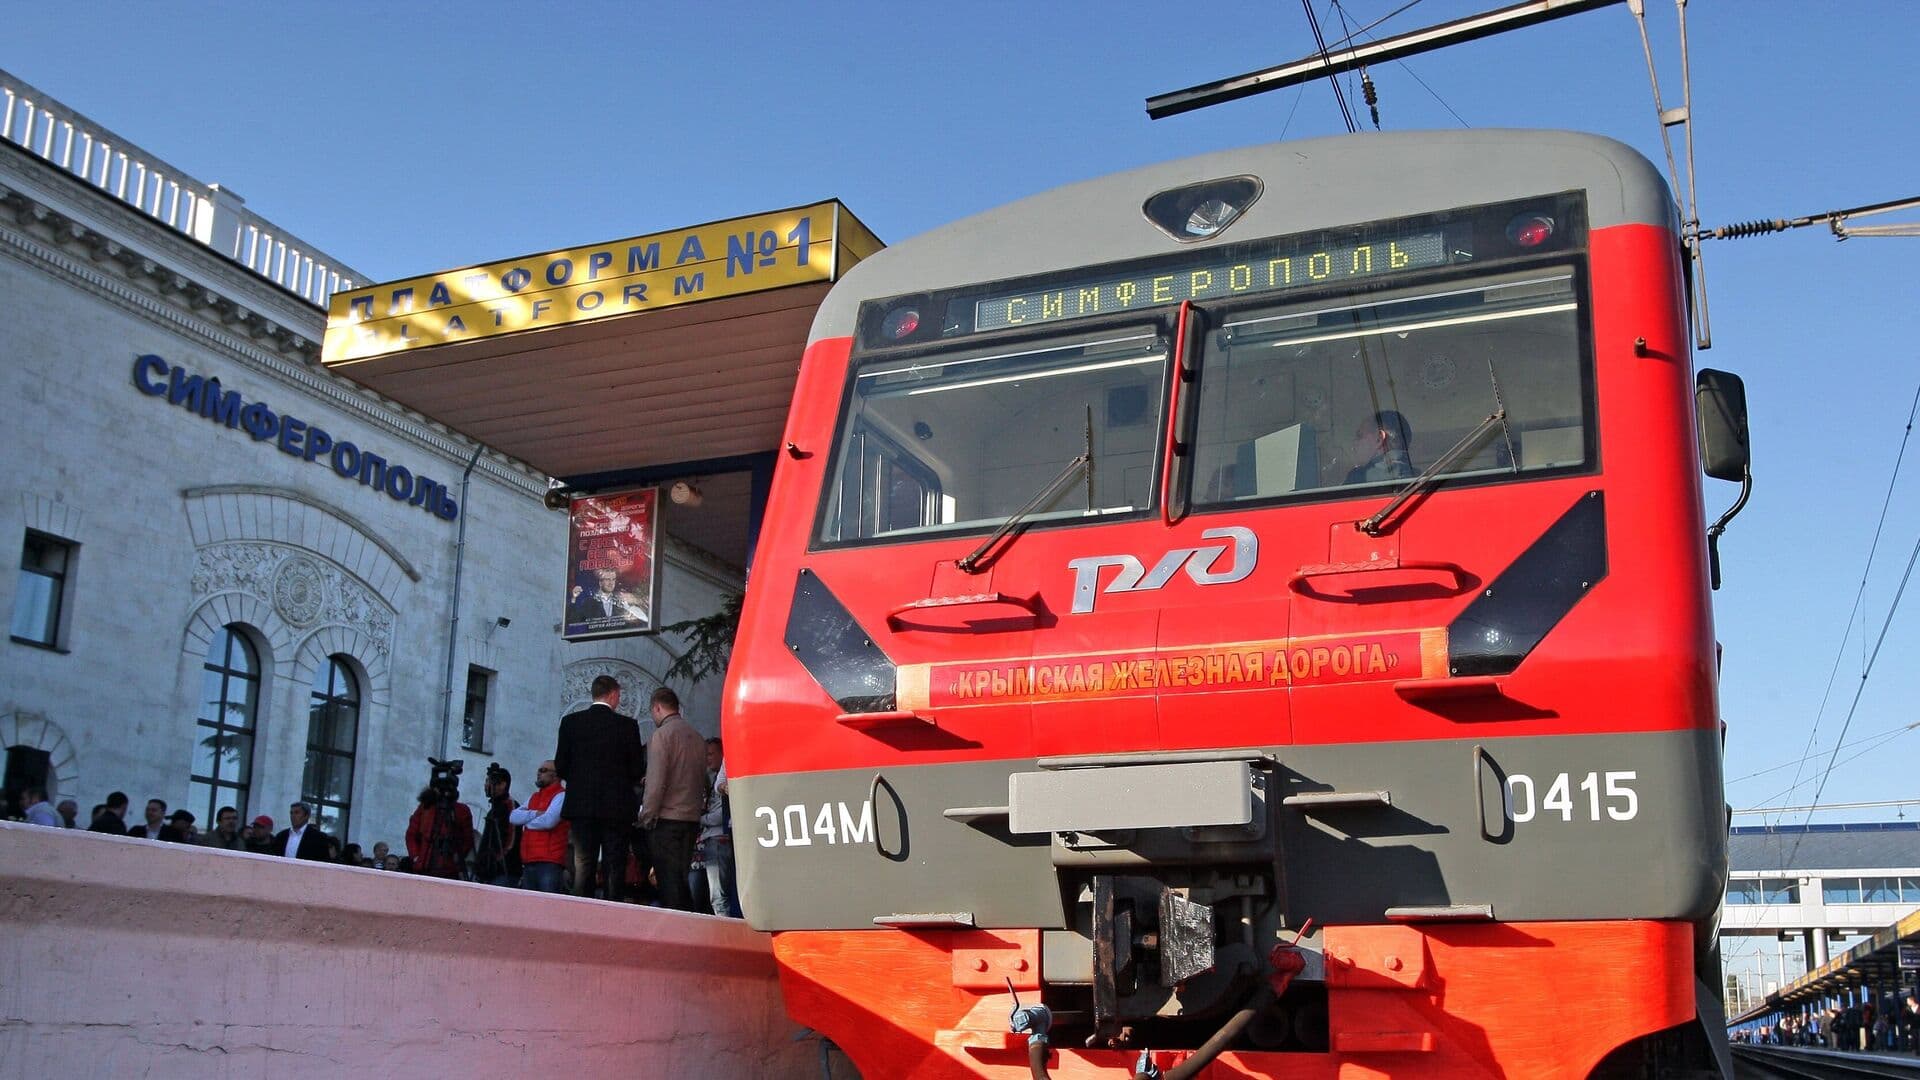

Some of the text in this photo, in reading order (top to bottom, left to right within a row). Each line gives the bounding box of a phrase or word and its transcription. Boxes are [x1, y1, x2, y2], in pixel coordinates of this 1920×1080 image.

[360, 272, 705, 350] LATFORM
[1006, 242, 1409, 324] СИМФЕРОПОЛЬ
[133, 354, 459, 521] СИМФЕРОПОЛЬ
[948, 643, 1400, 700] «КРЫМСКАЯ ЖЕЛЕЗНАЯ ДОРОГА»
[755, 801, 874, 848] ЭД4М
[1503, 771, 1639, 823] 0415
